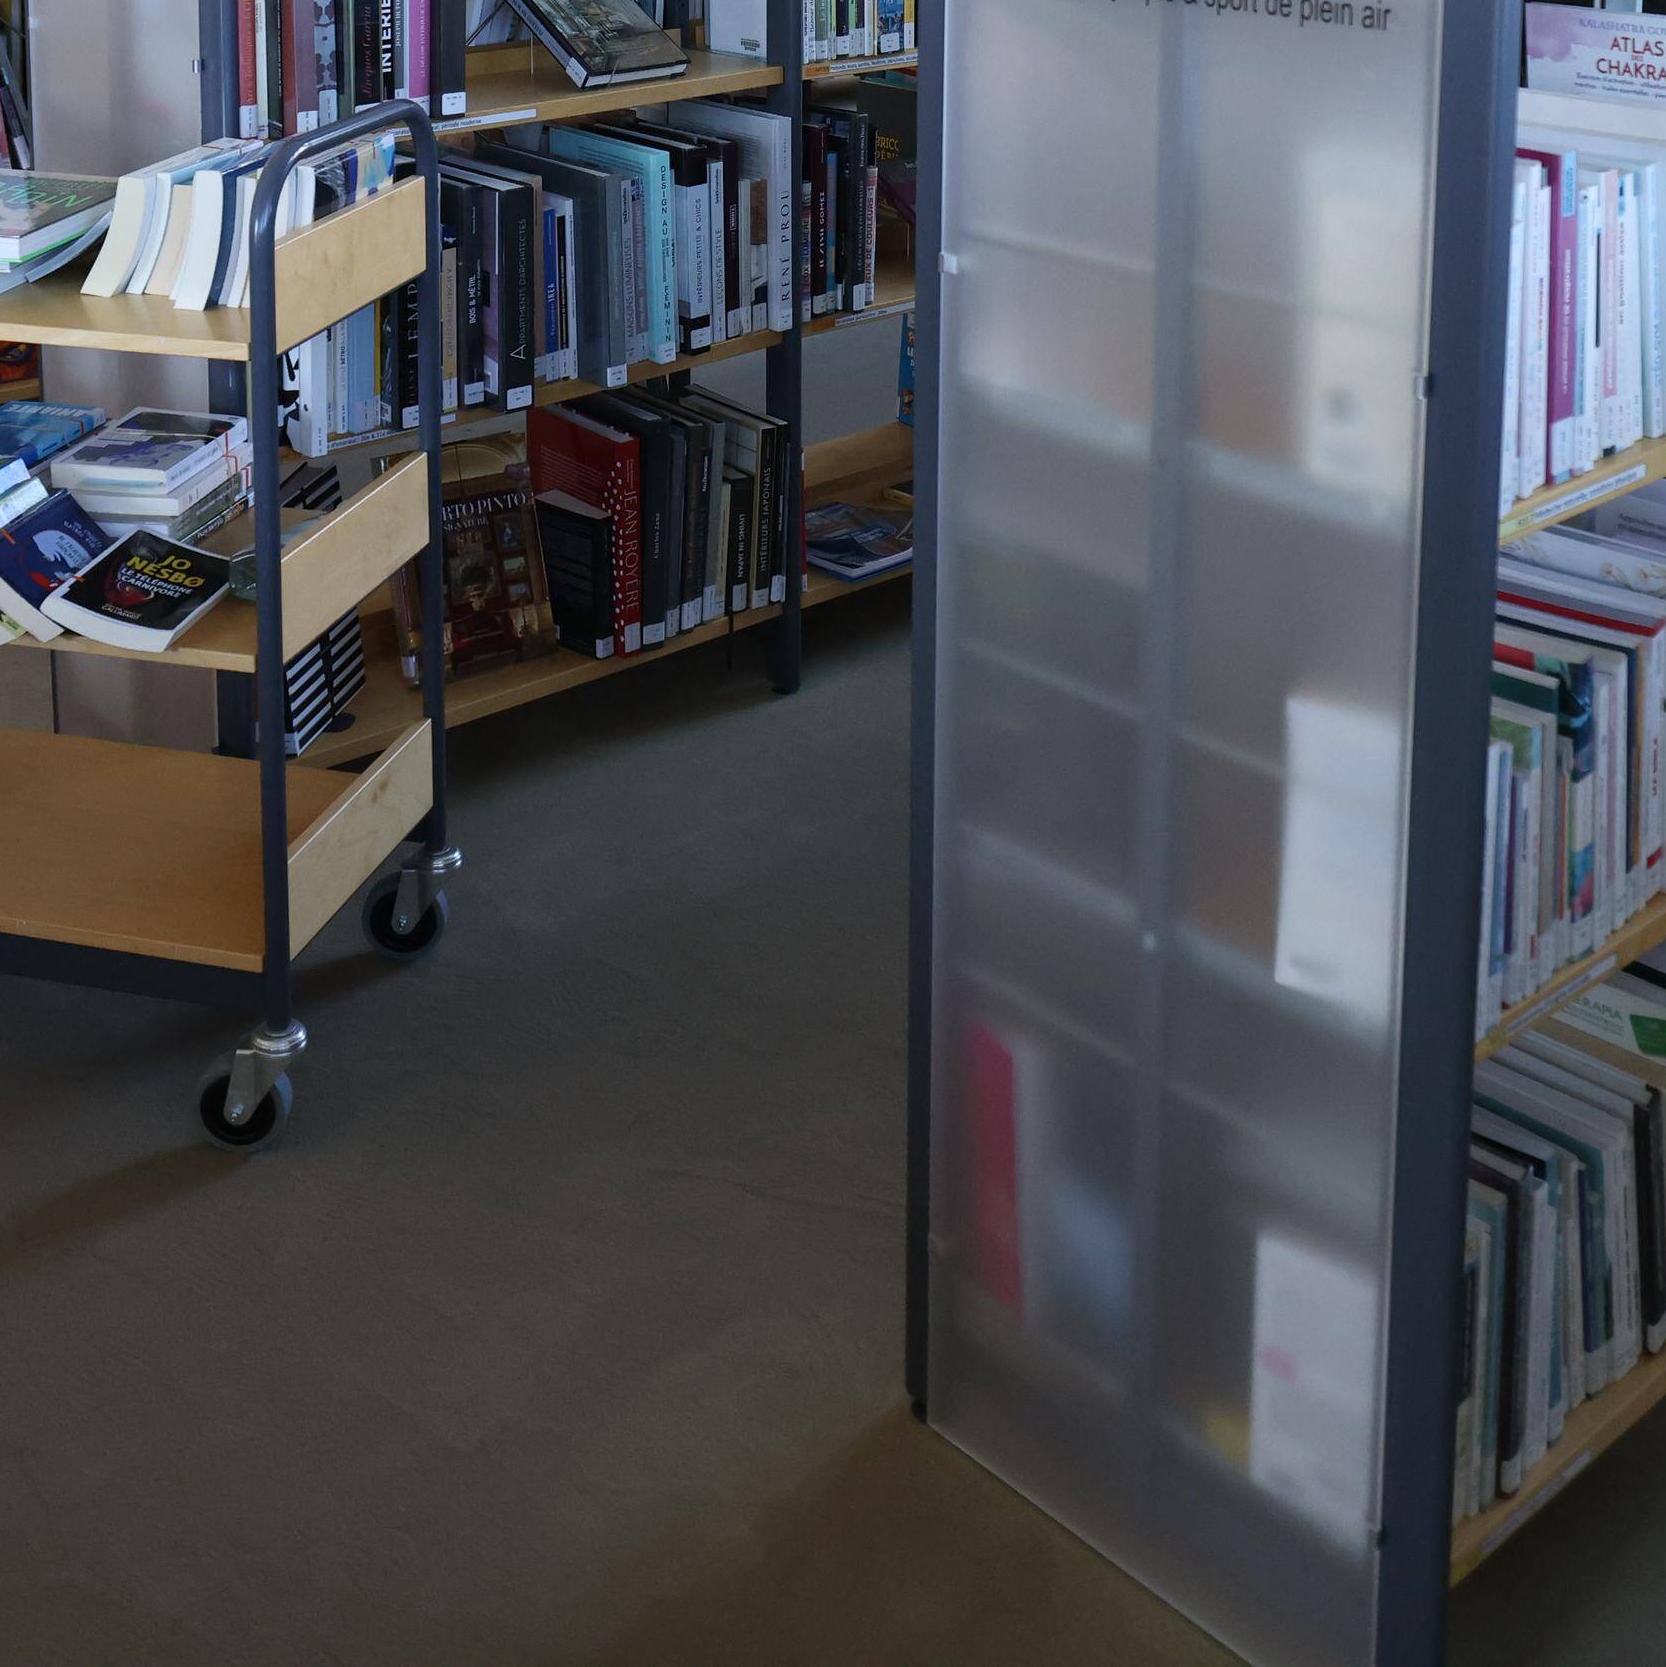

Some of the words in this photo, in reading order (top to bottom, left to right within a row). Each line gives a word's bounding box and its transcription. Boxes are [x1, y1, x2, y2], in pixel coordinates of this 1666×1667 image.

[394, 22, 402, 47] JOSEPH
[1610, 35, 1666, 57] ATLAS
[361, 49, 374, 98] Jacques
[659, 165, 669, 214] DESIGN
[694, 197, 702, 223] CHICS
[778, 189, 791, 244] PROU
[865, 197, 874, 246] COULEURS
[659, 220, 669, 235] AU
[714, 227, 724, 255] STYLE
[694, 233, 703, 259] PETITS
[865, 247, 874, 263] DE
[623, 237, 635, 297] LUMINEUSES
[714, 255, 724, 268] DE
[466, 273, 477, 297] MÉTAL
[546, 282, 556, 303] IKEA
[694, 260, 703, 304] INTÉRIEURS
[714, 268, 724, 305] LEÇONS
[778, 256, 791, 302] RENÉ
[467, 307, 477, 324] BOIS
[623, 296, 635, 338] MAISONS
[662, 284, 671, 341] FÉMININ
[478, 492, 527, 515] PINTO
[761, 467, 772, 516] JAPONAIS
[624, 489, 638, 534] JEAN
[737, 513, 746, 540] LIVING
[737, 542, 746, 552] IN
[760, 518, 770, 571] INTÉRIEURS
[121, 567, 134, 577] LE
[124, 556, 206, 589] NESBØ
[157, 554, 193, 571] JO
[624, 541, 640, 610] ROYÈRE
[737, 553, 746, 578] JAPAN
[121, 575, 183, 599] CARNIVORE
